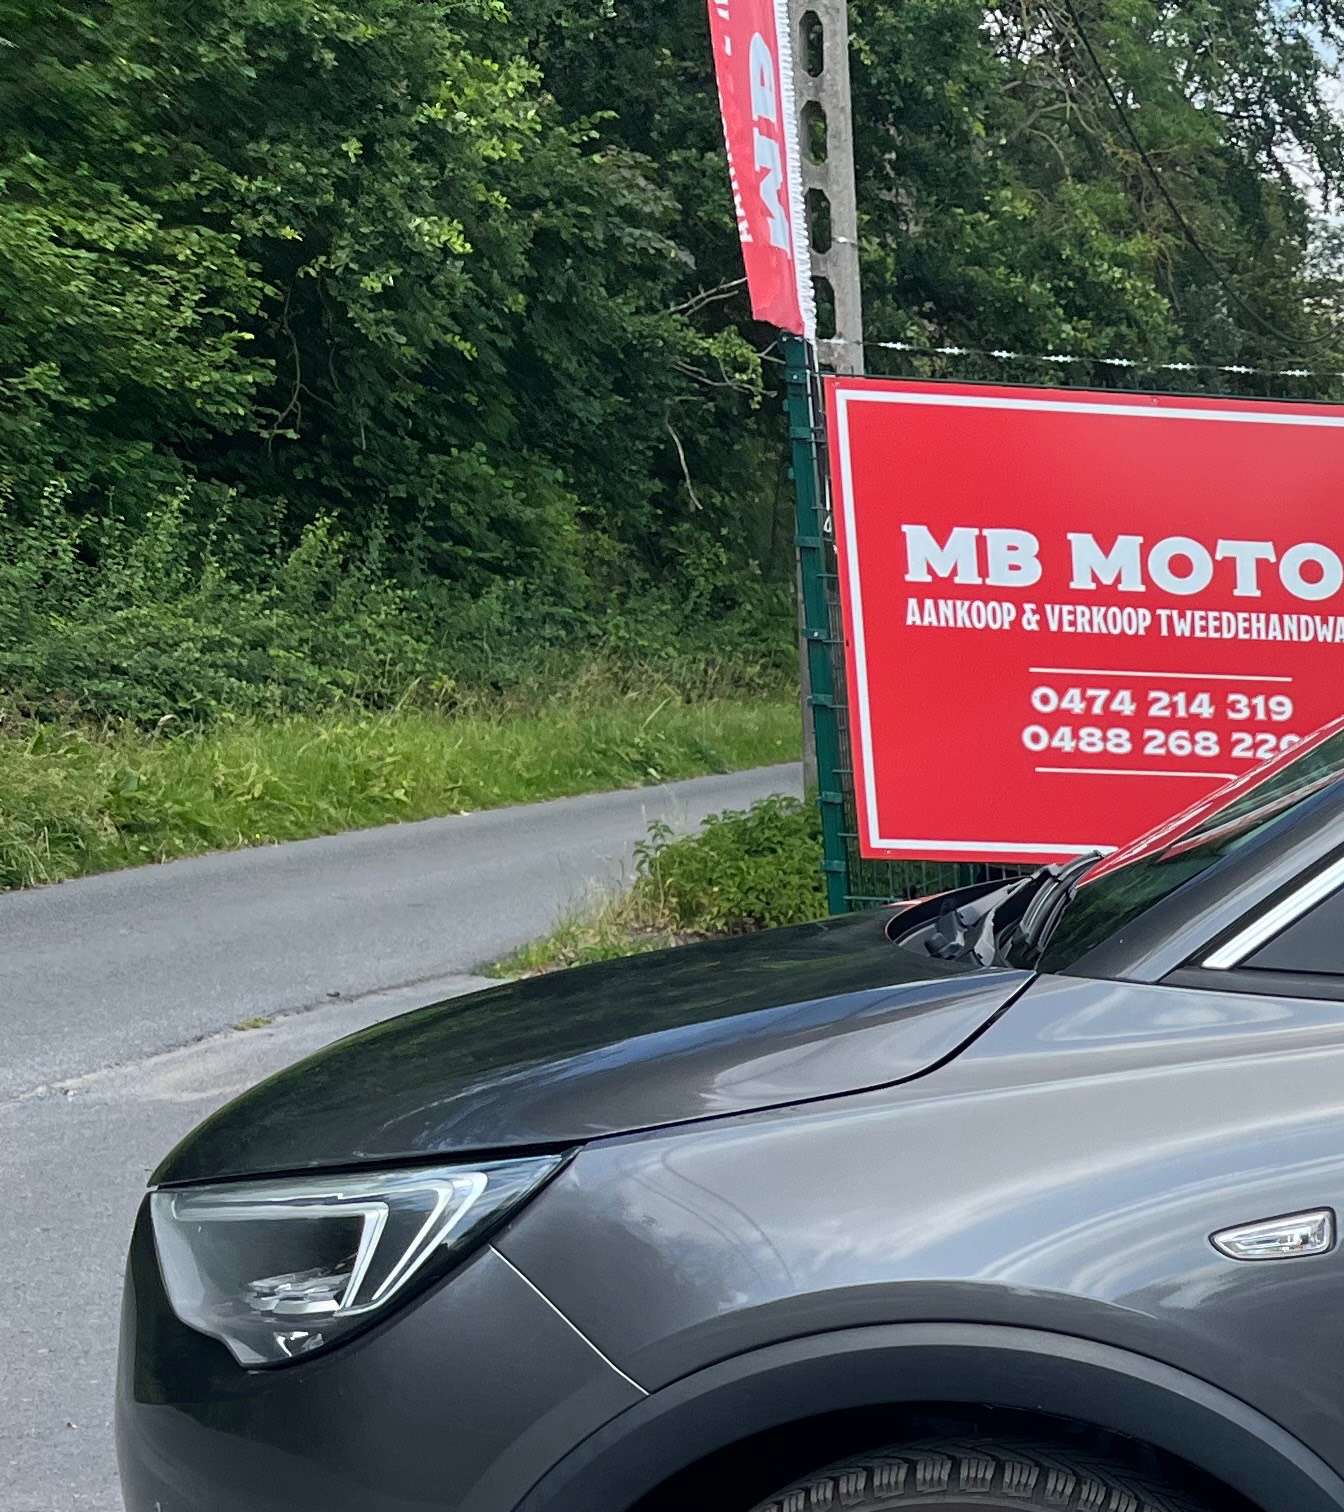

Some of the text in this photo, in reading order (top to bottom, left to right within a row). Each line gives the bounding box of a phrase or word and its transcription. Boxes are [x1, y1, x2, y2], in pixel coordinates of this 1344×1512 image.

[901, 524, 1042, 588] MB
[905, 597, 1016, 630] AANKOOP
[1021, 602, 1041, 631] &
[1044, 604, 1152, 636] VERKOOP
[1031, 686, 1294, 721] 0474 214 319
[1021, 724, 1132, 756] 0488
[1143, 728, 1220, 757] 268
